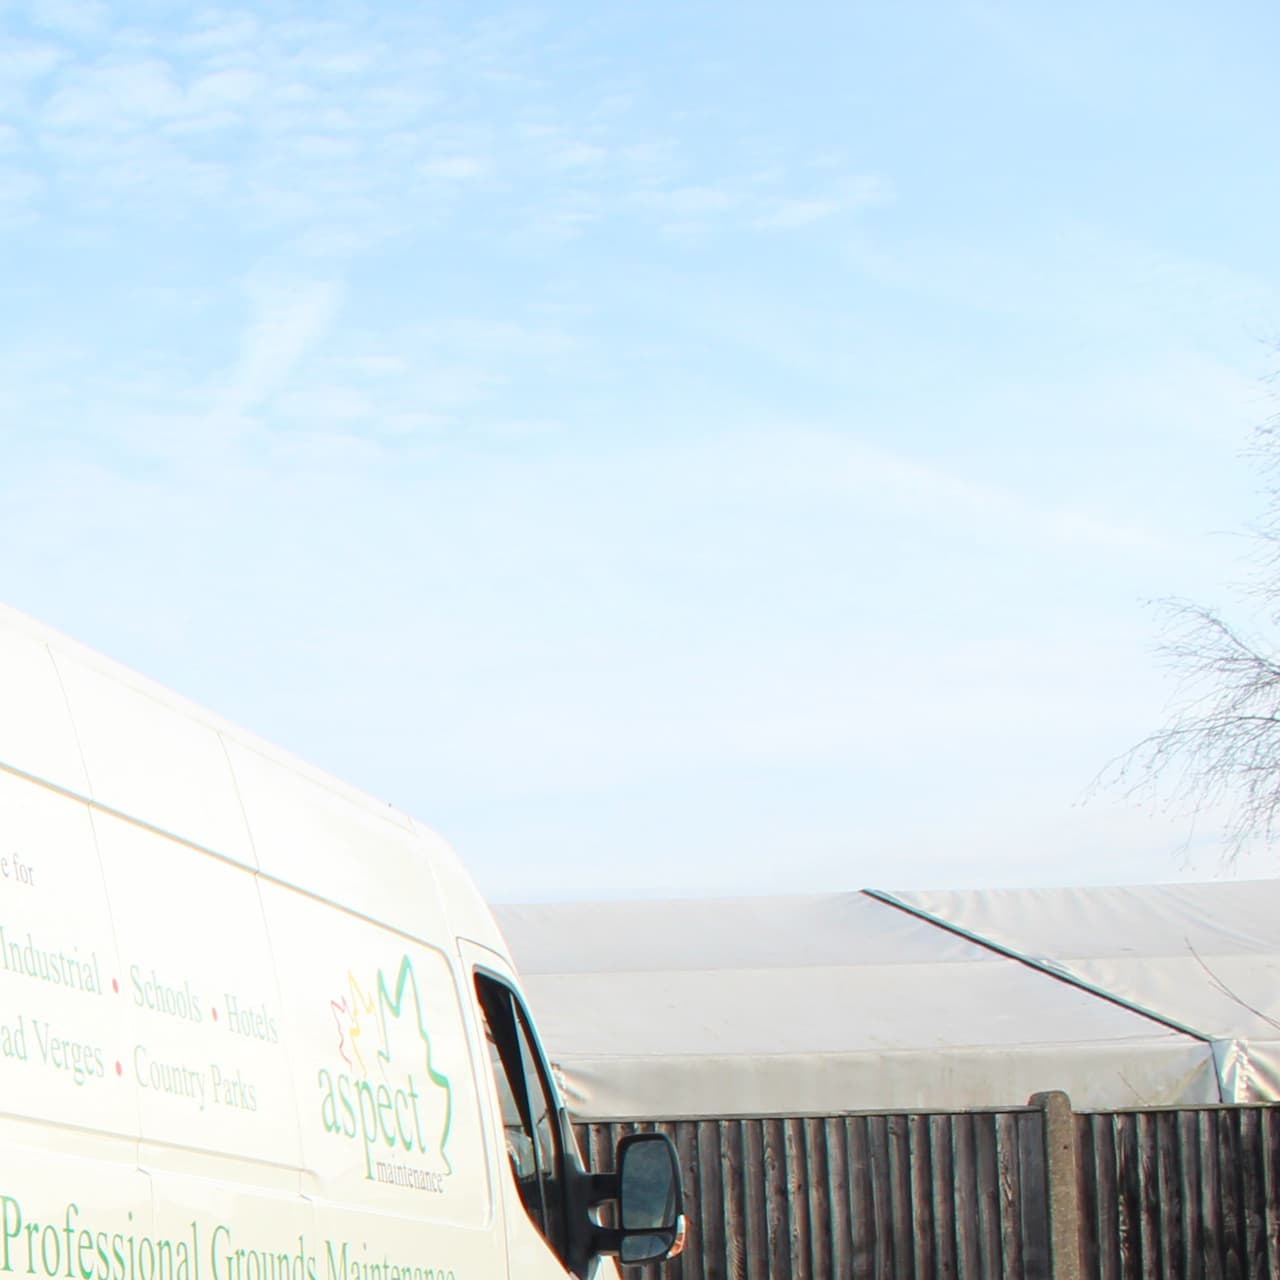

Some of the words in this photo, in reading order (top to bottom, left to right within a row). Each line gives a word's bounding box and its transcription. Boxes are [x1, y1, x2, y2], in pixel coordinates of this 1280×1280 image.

[12, 852, 35, 887] for
[130, 964, 203, 1023] Schools
[224, 993, 280, 1044] Hotels
[32, 1019, 105, 1086] Verges
[133, 1044, 206, 1112] Country
[210, 1063, 258, 1112] Parks
[317, 1068, 427, 1181] aspect
[376, 1153, 444, 1194] maintenance
